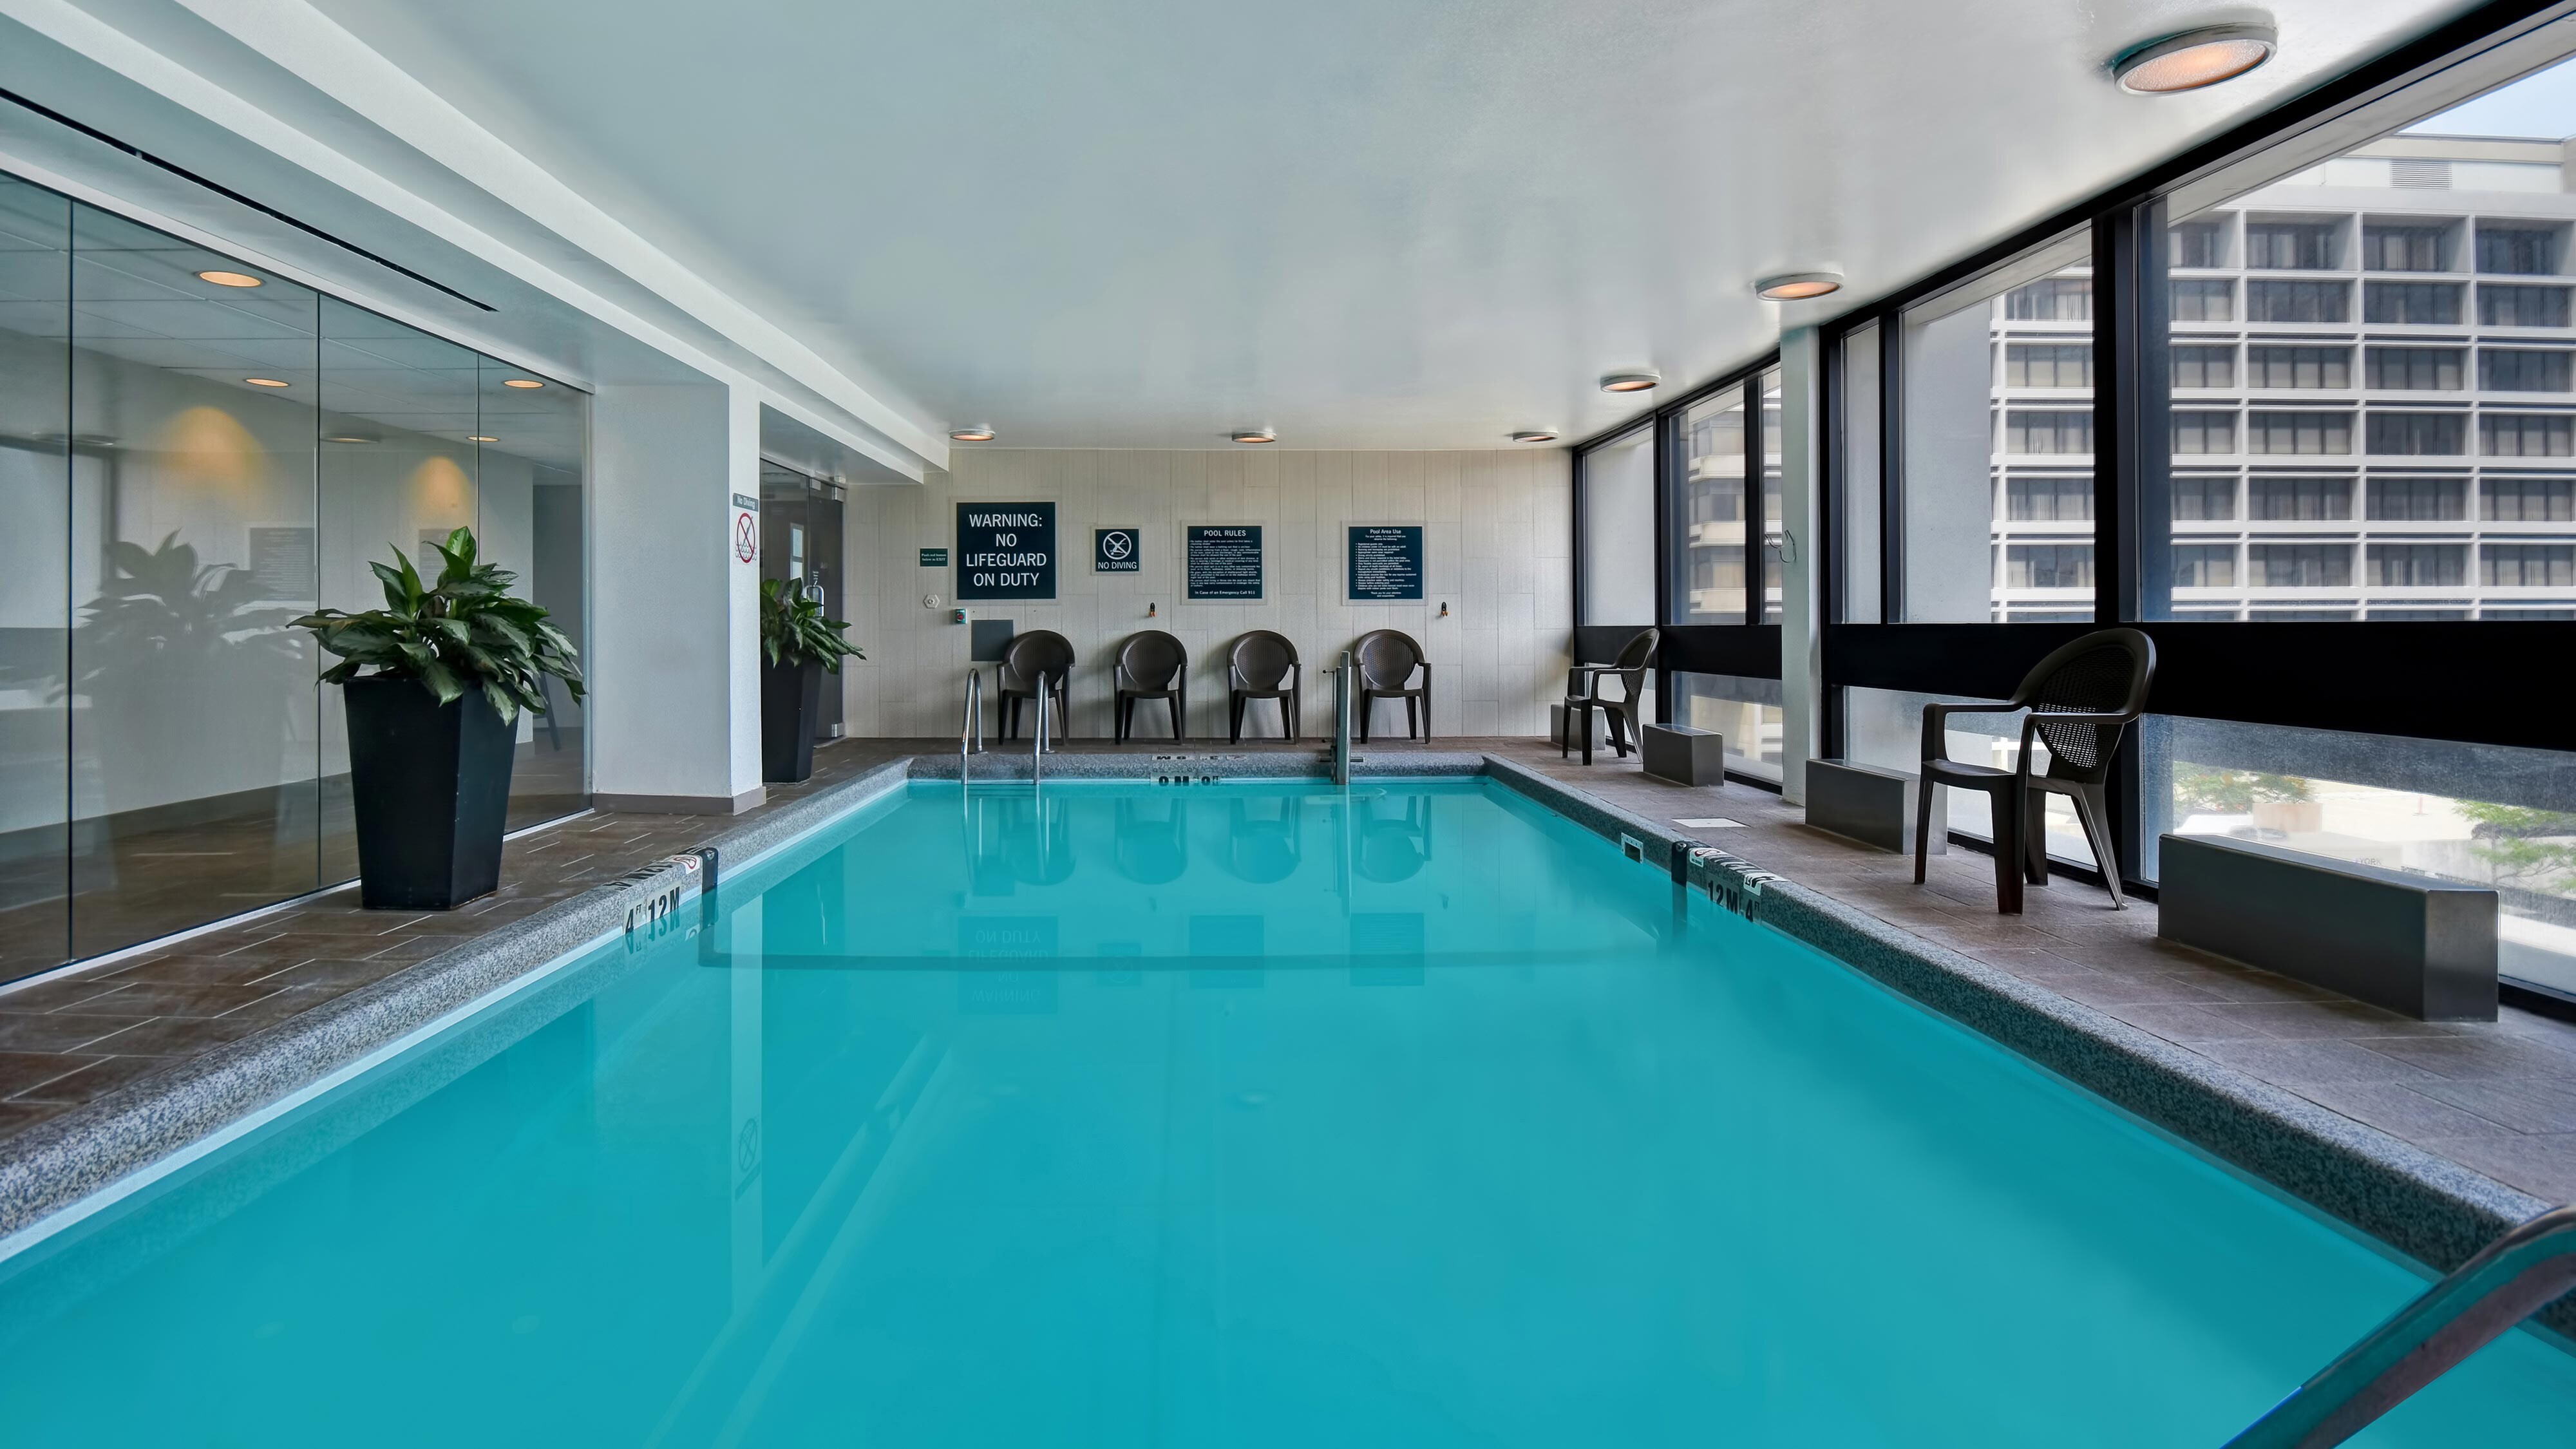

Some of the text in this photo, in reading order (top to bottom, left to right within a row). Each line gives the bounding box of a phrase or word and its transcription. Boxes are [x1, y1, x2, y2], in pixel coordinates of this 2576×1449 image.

[737, 495, 755, 509] No Diving
[969, 514, 1042, 527] WARNING:
[996, 534, 1017, 547] NO
[966, 553, 1046, 566] LIFEGUARD
[974, 573, 1039, 586] ON DUTY
